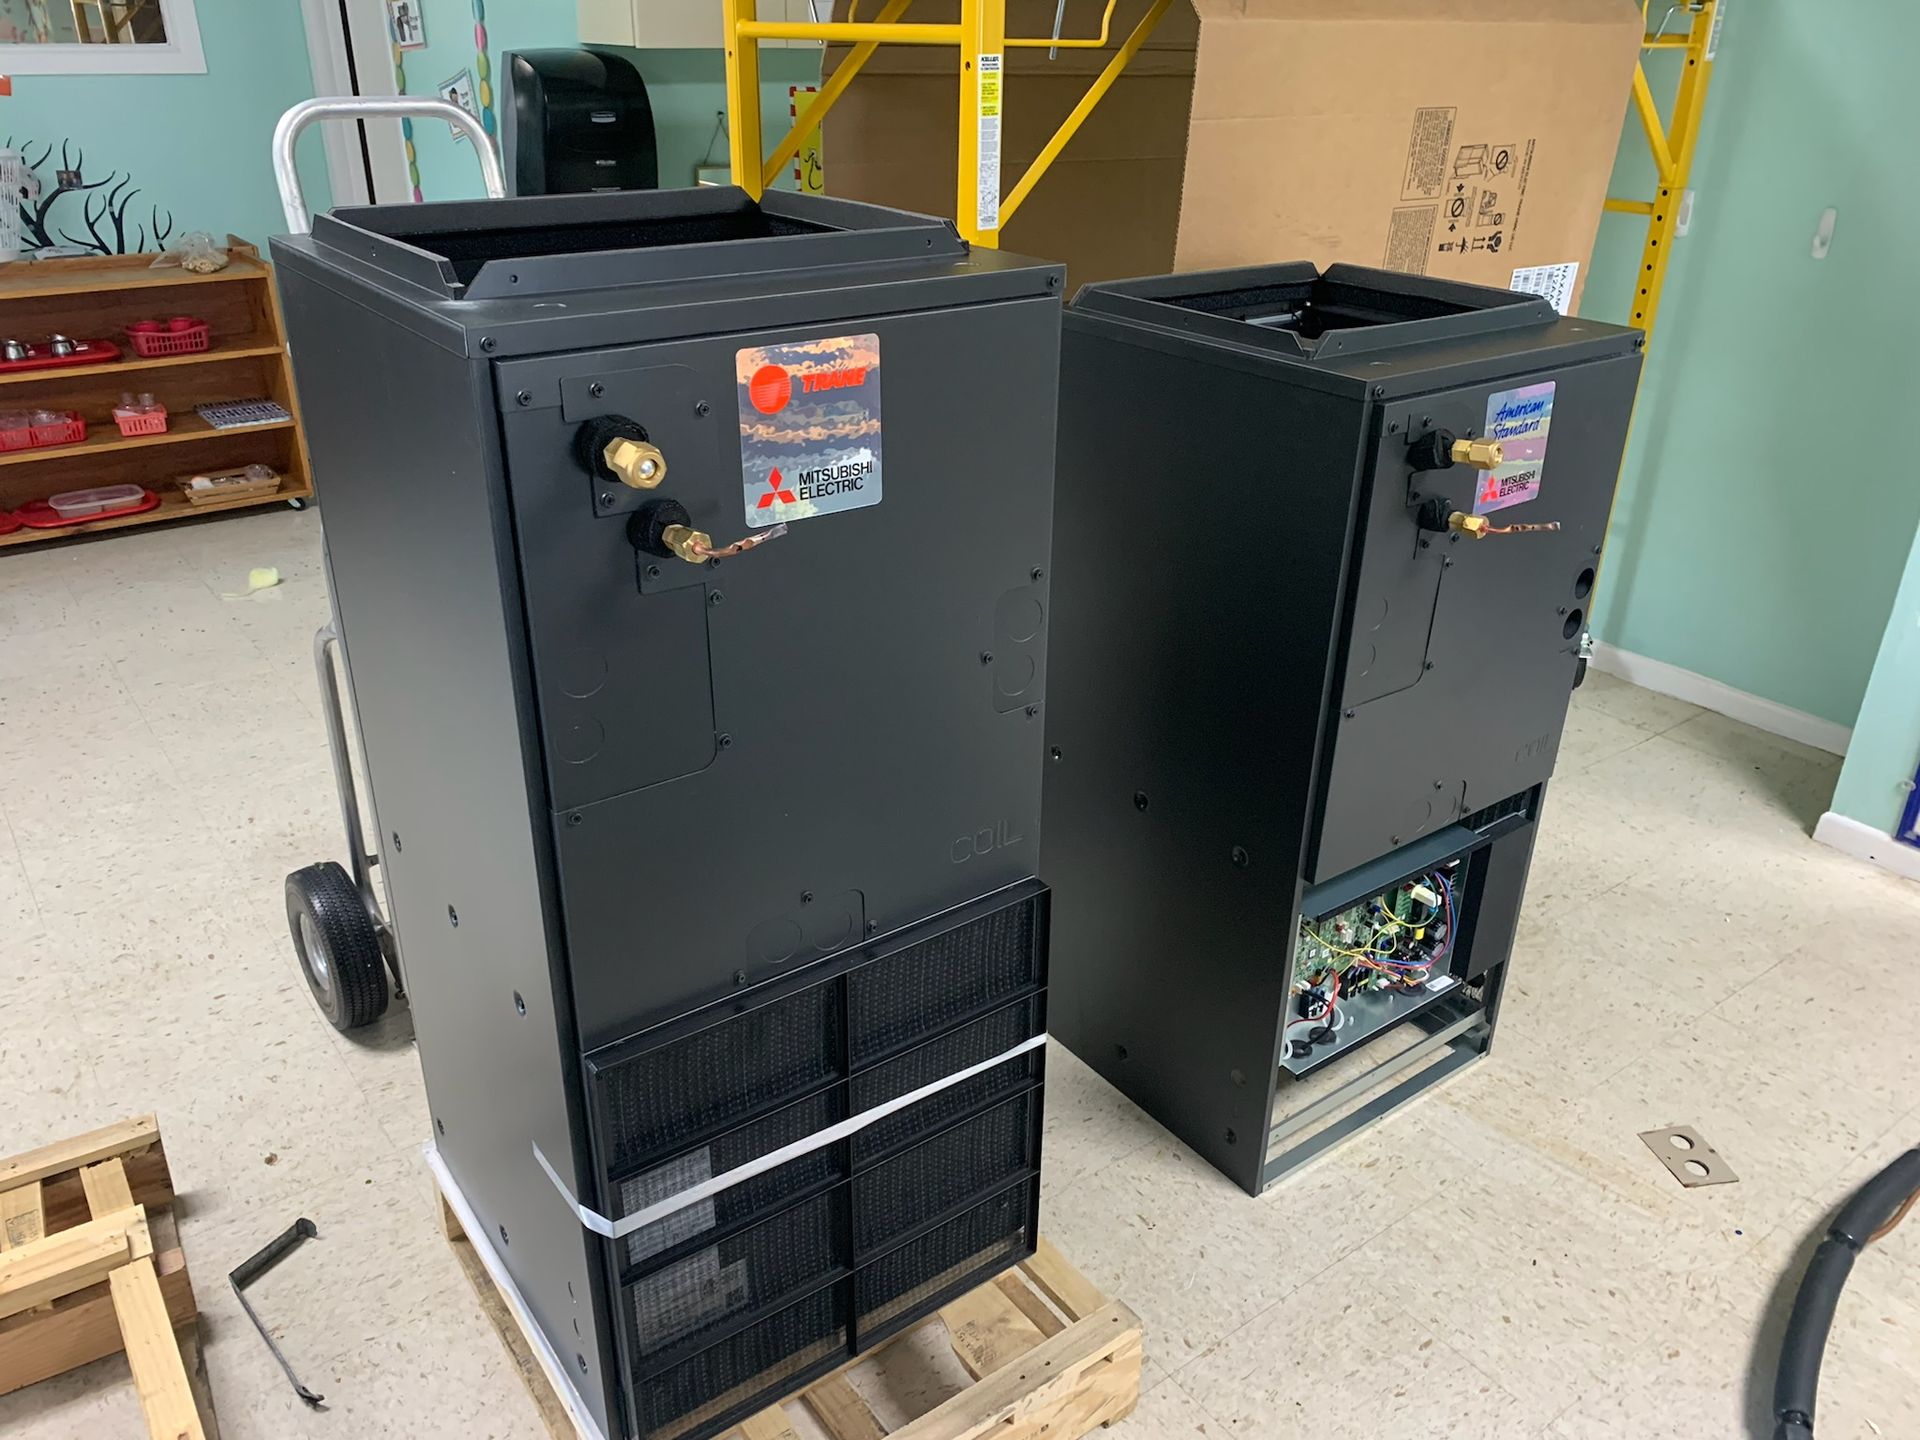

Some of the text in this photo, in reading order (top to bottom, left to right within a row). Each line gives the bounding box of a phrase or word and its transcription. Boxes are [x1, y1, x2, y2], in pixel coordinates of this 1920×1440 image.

[1555, 265, 1569, 311] NAXAM
[802, 367, 867, 393] TRANE
[1494, 400, 1545, 423] American
[1493, 413, 1543, 440] Standard
[799, 460, 873, 486] MITSUBISHI
[1501, 470, 1536, 487] MITSUBISHI
[800, 477, 864, 501] ELECTRIC
[1499, 481, 1530, 497] ELECTRIC
[951, 820, 1024, 864] COIL
